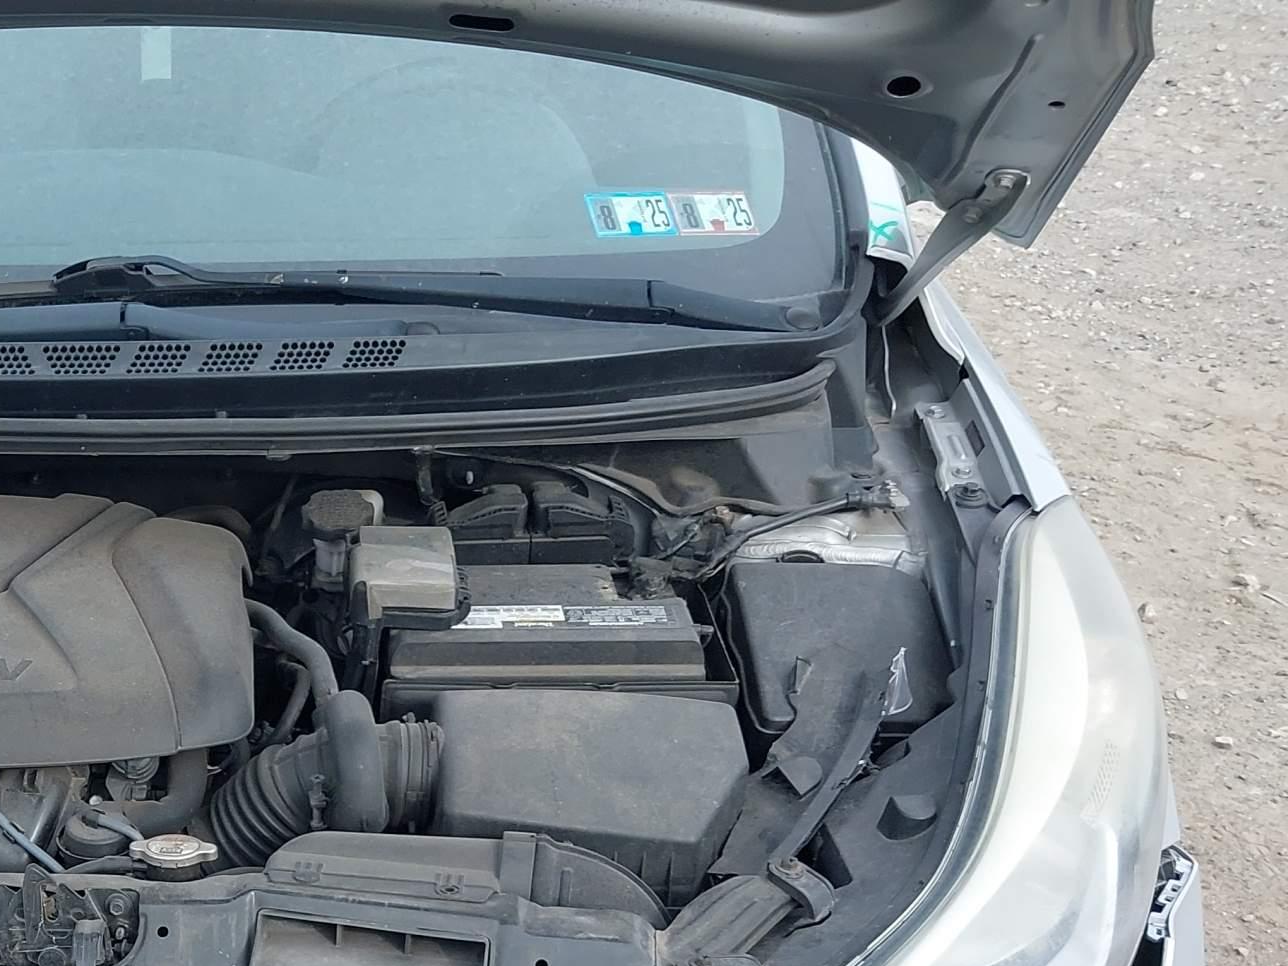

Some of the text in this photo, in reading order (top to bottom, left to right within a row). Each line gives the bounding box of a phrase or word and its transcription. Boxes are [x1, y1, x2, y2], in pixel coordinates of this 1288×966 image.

[599, 205, 617, 231] 8
[645, 199, 671, 228] 25
[682, 202, 700, 229] 8
[726, 197, 753, 228] 25
